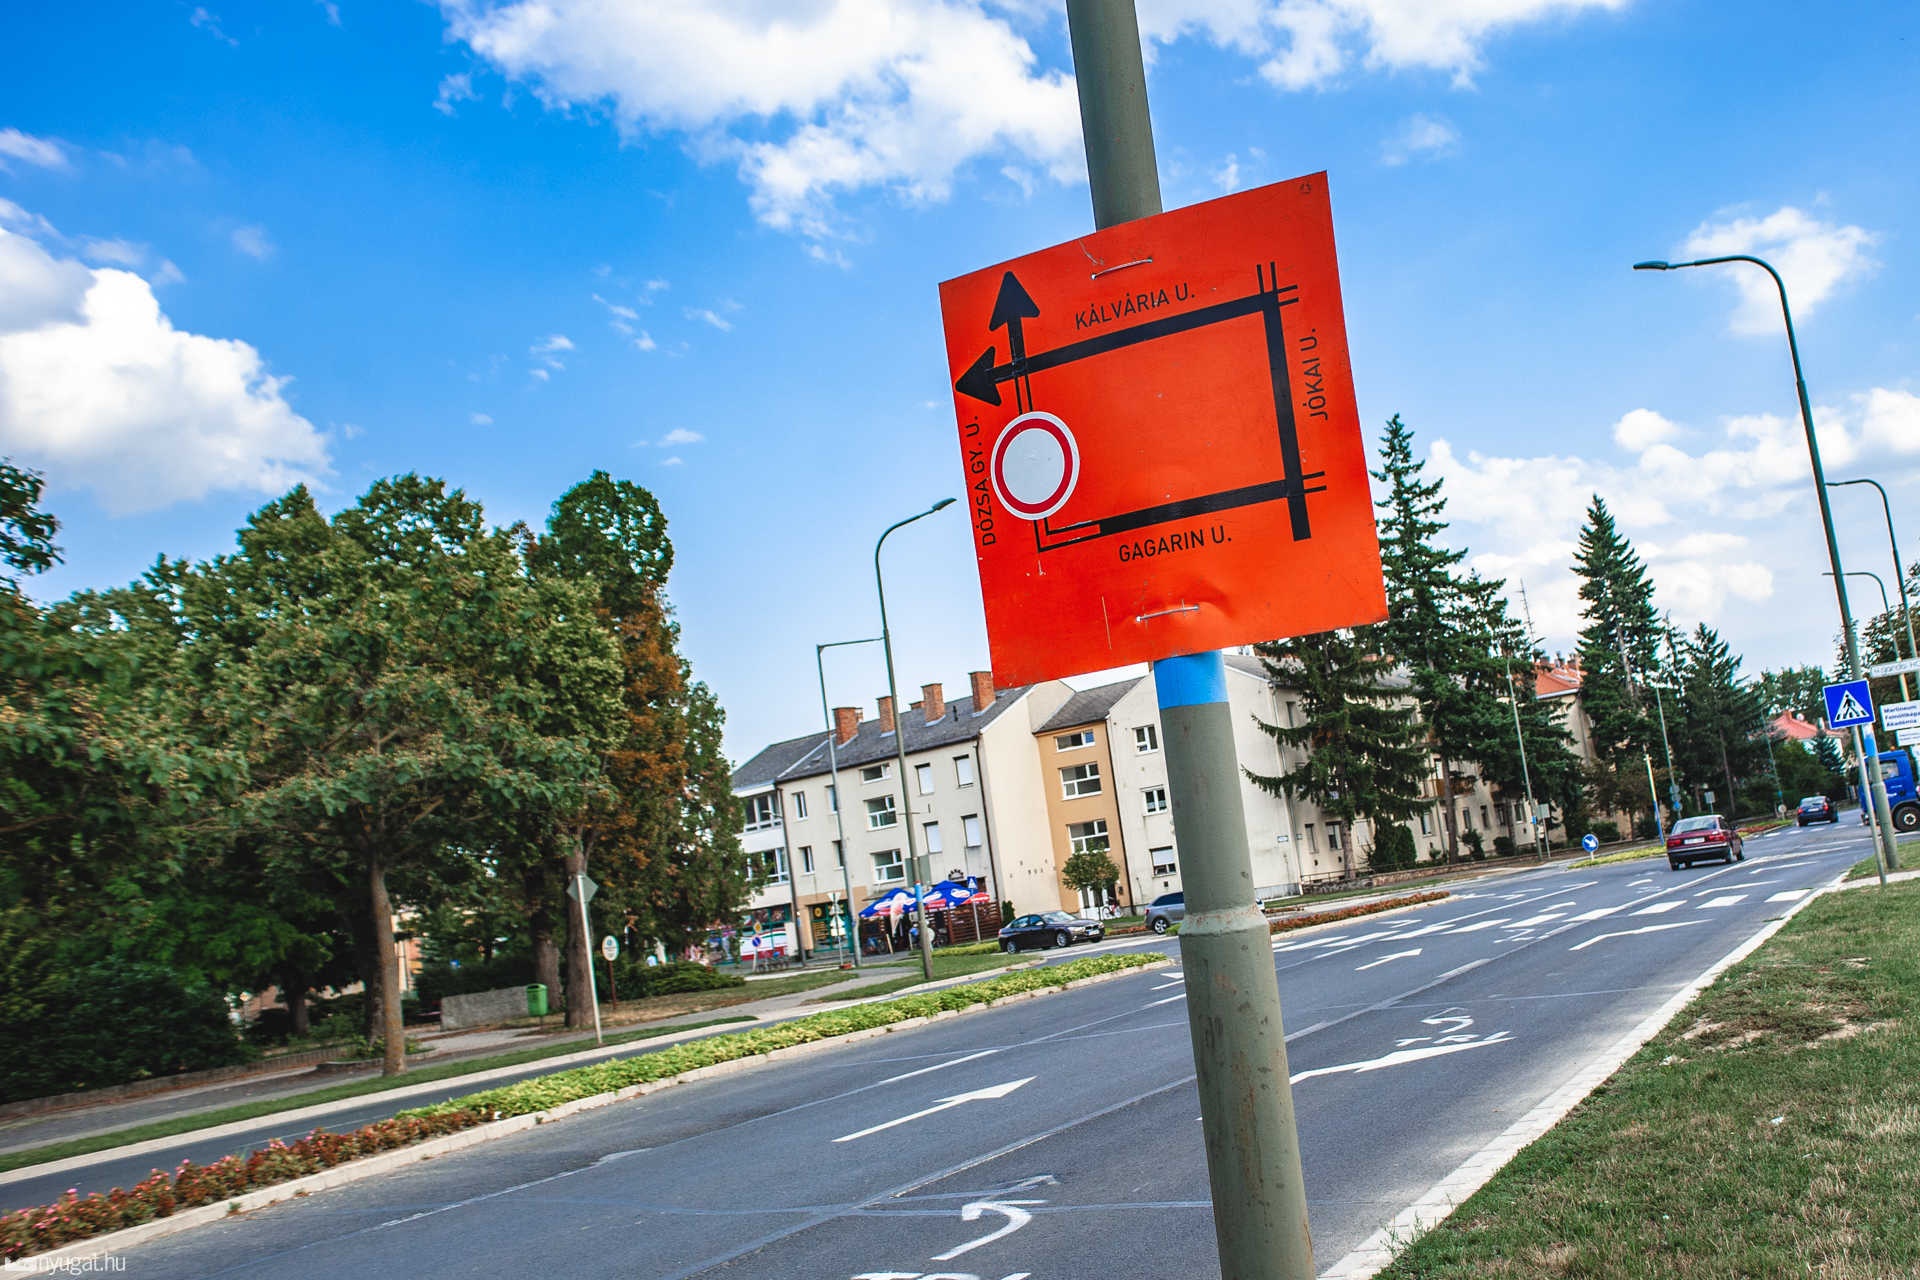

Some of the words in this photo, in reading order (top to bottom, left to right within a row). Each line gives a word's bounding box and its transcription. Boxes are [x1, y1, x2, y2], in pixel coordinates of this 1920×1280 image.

[1075, 288, 1171, 331] KÁLVÁRIA
[1175, 281, 1195, 302] U.
[1299, 328, 1318, 352] U.
[1302, 357, 1328, 421] JÓKAI
[965, 415, 980, 438] U.
[968, 441, 986, 475] GY.
[1119, 528, 1205, 562] GAGARIN
[1211, 524, 1232, 544] U.
